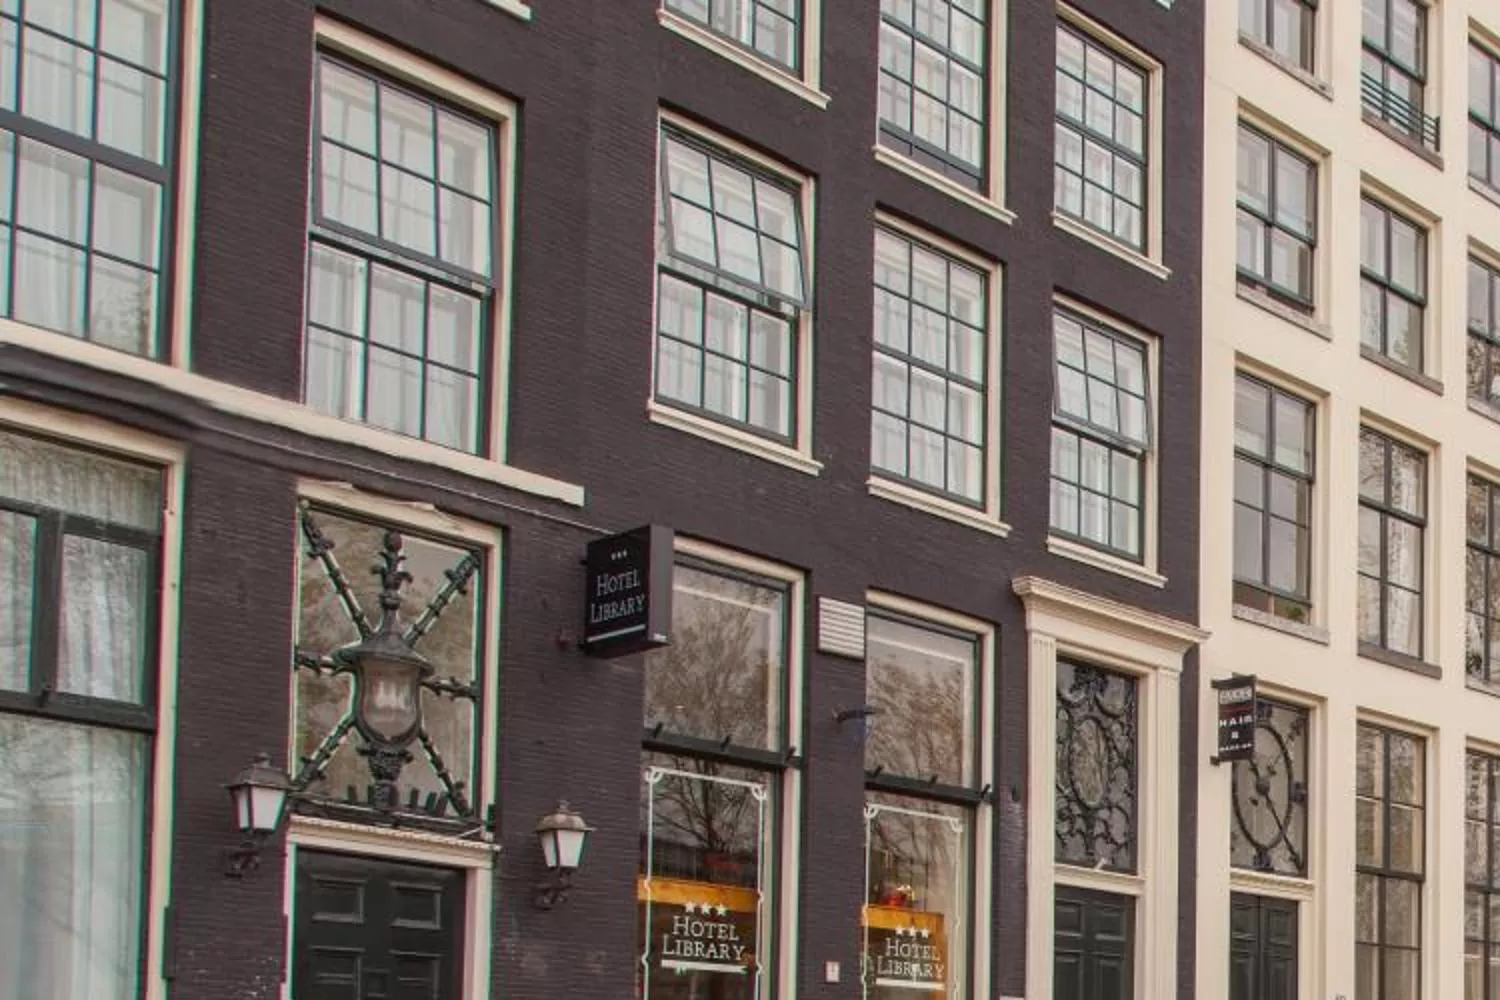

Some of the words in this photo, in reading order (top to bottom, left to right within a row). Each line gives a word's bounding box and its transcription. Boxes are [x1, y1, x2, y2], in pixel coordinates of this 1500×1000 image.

[597, 568, 640, 596] HOTEL
[590, 593, 645, 623] LIBRARY
[672, 915, 739, 941] HOTEL
[662, 934, 745, 961] LIBRARY
[885, 937, 941, 961] HOTEL
[877, 956, 945, 979] LIBRARY
